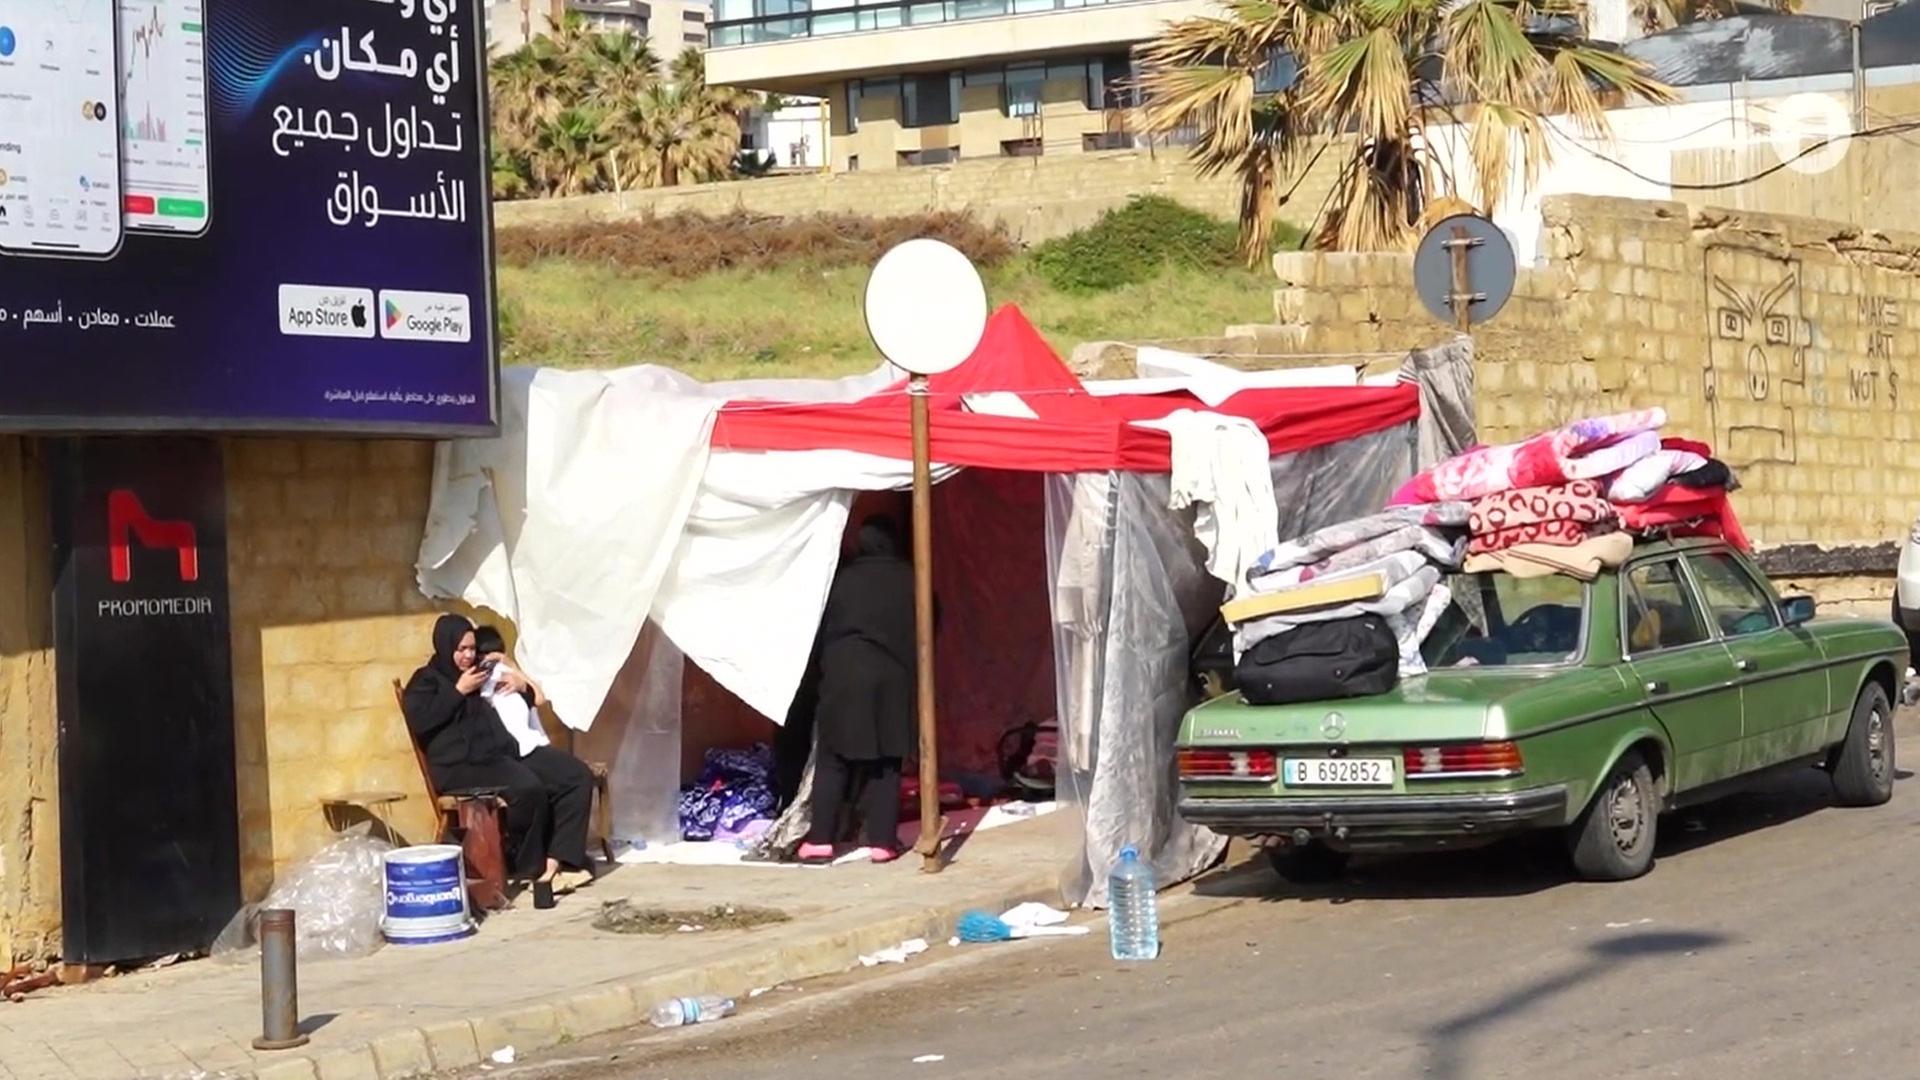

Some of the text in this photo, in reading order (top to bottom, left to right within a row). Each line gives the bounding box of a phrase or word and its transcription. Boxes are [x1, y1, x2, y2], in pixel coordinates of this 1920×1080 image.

[304, 25, 460, 104] أي مكان.
[272, 103, 462, 159] تداول جميع
[327, 170, 466, 227] الأسواق
[23, 299, 63, 331] أسهم
[78, 307, 120, 330] معادن
[134, 310, 176, 328] عملات
[288, 307, 348, 328] App Store
[406, 315, 464, 336] Google Play
[1857, 294, 1899, 328] MAKE
[1867, 330, 1893, 361] ART
[1849, 369, 1879, 402] NOT
[98, 597, 213, 617] PROMOMEDIA
[1298, 762, 1381, 782] B 692852
